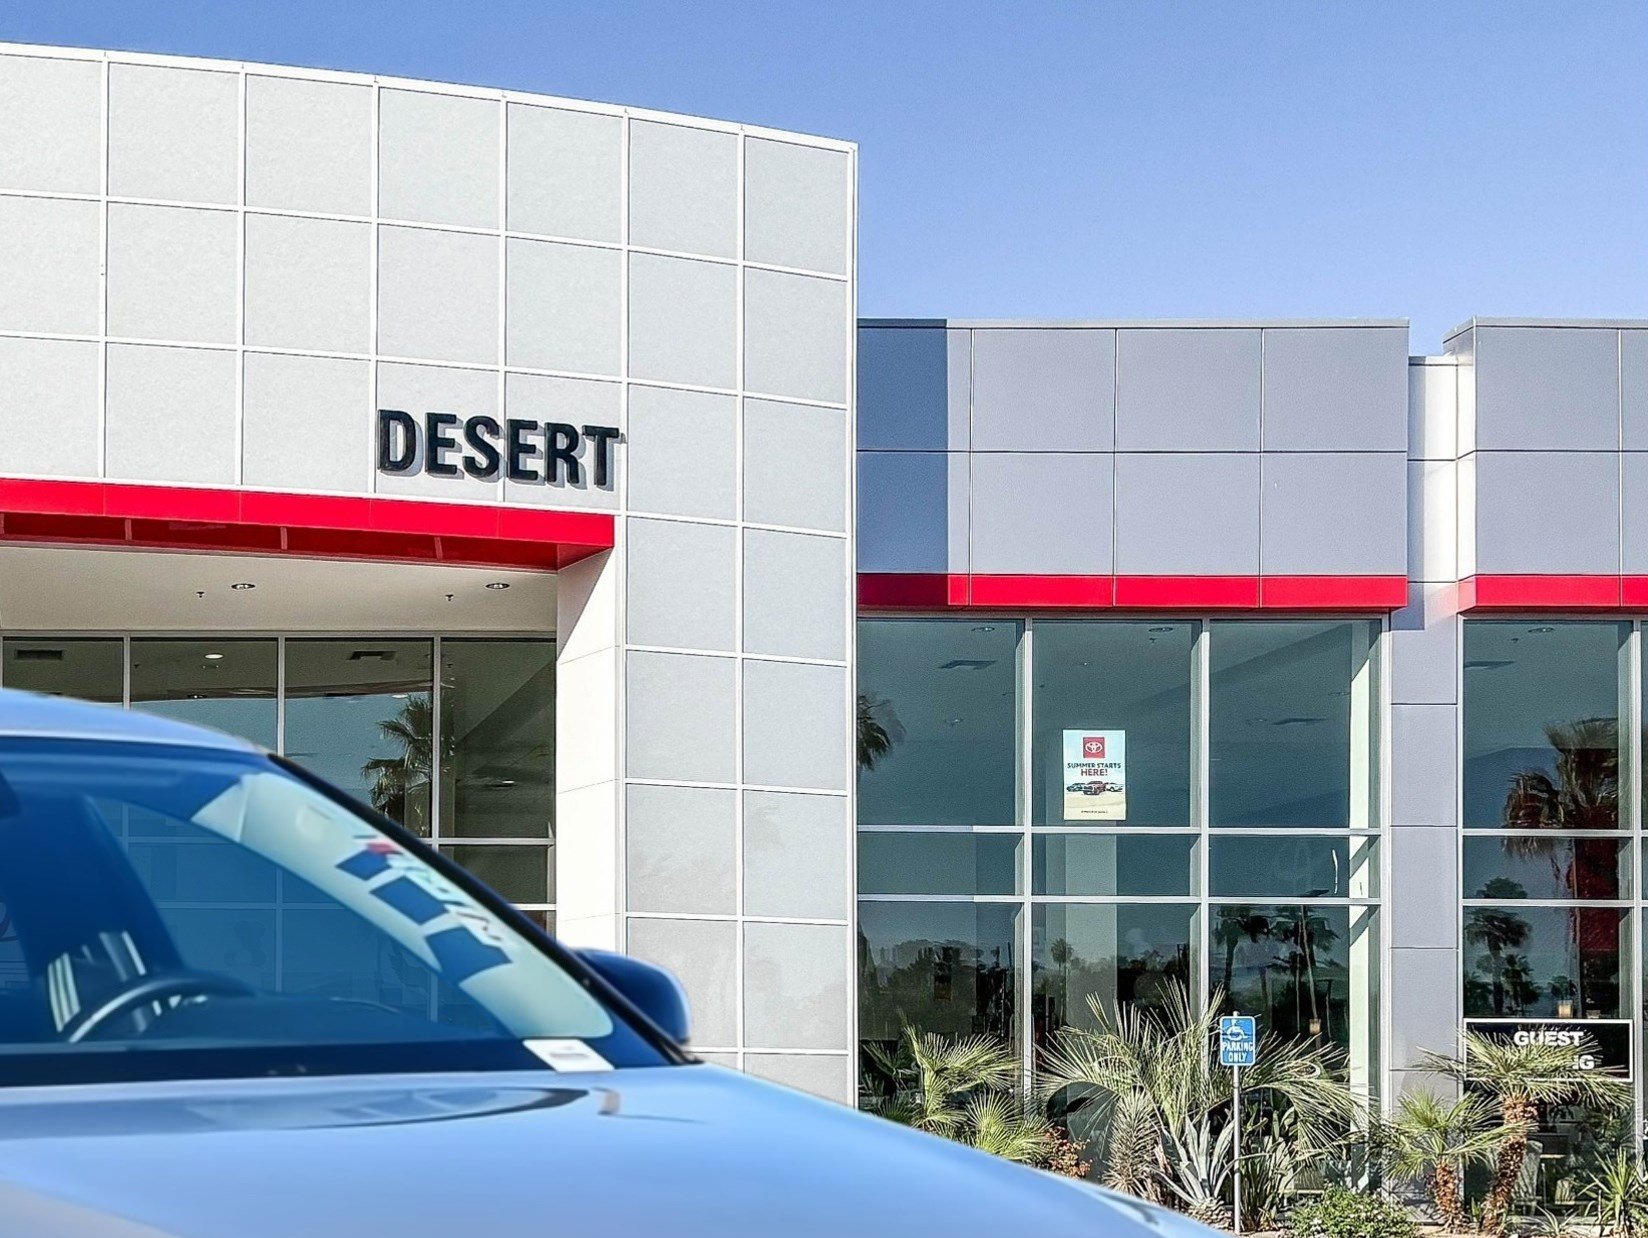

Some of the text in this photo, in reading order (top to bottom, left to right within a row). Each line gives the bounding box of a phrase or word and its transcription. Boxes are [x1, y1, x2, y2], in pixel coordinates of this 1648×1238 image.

[377, 409, 620, 487] DESERT
[1513, 1031, 1584, 1046] GUEST
[1222, 1041, 1253, 1051] PARKING
[1229, 1052, 1247, 1062] ONLY
